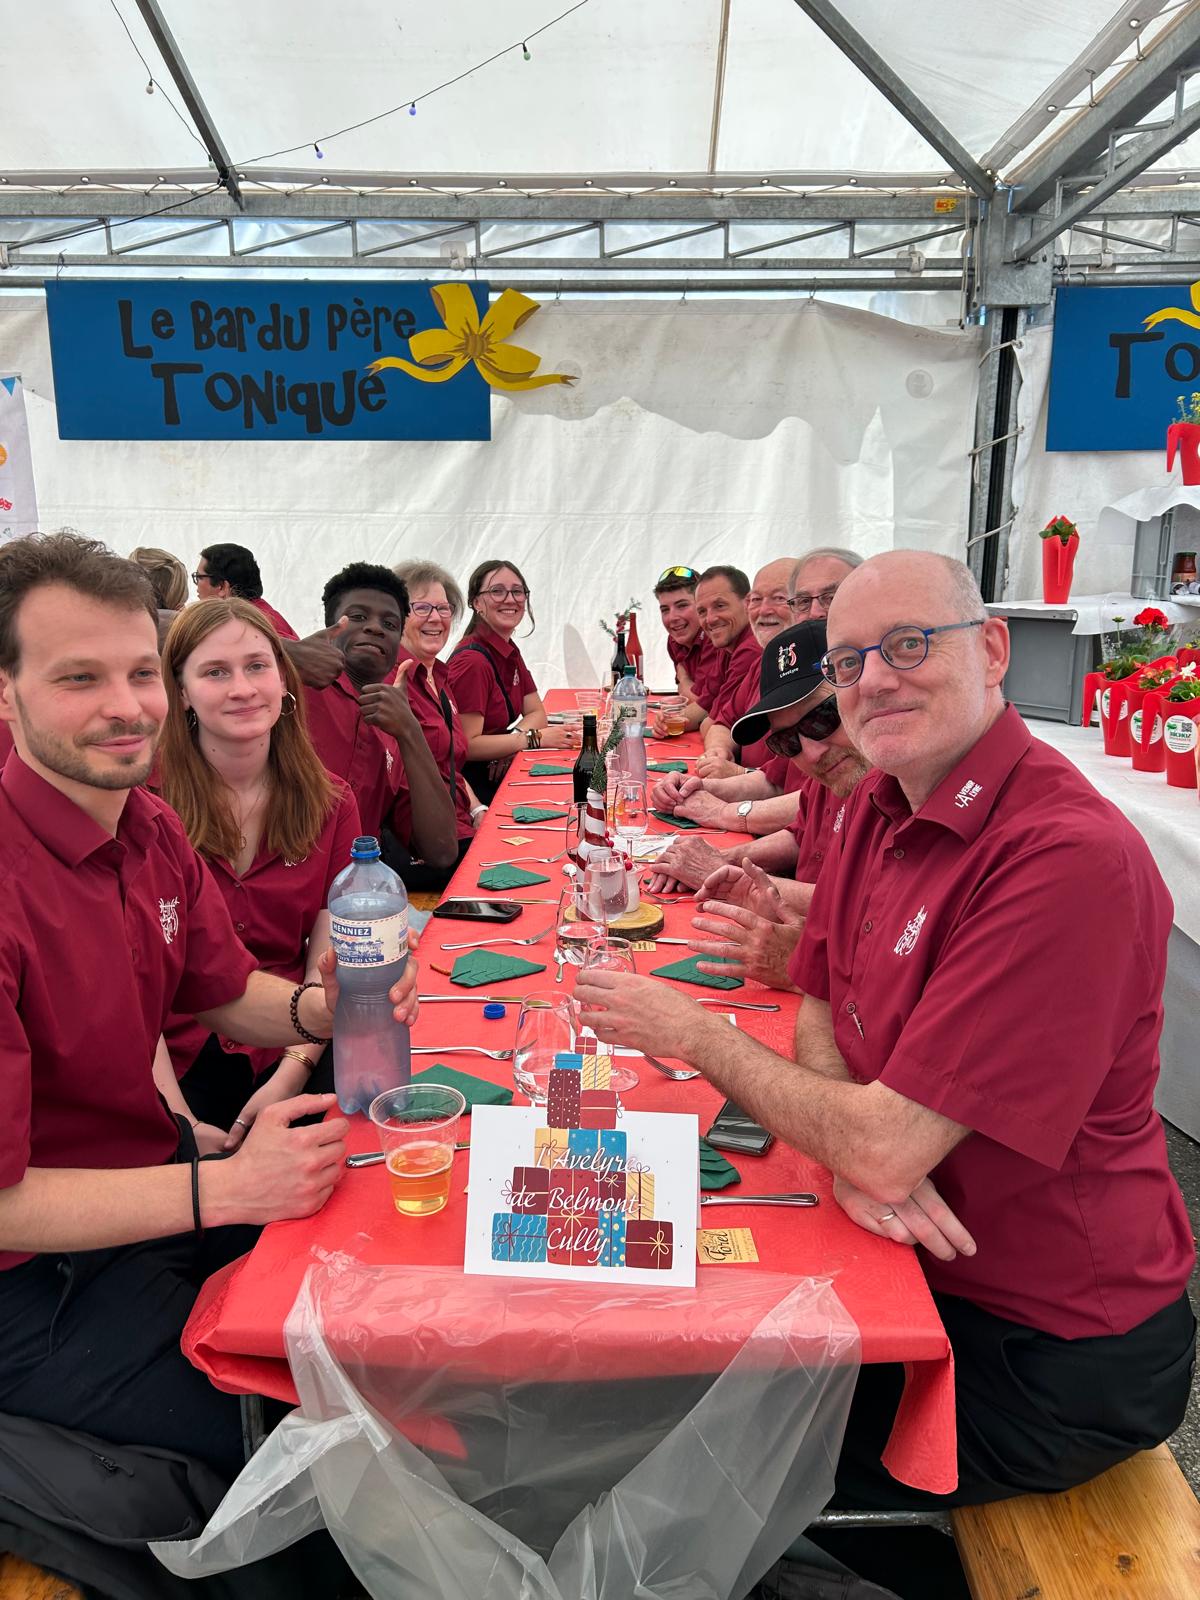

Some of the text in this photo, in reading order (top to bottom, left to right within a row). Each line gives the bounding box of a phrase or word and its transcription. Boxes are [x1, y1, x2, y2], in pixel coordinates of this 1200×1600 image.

[118, 299, 176, 359] Le
[190, 300, 256, 352] Bar
[333, 923, 370, 936] HENNIEZ
[536, 1146, 637, 1182] L'Avelyre
[510, 1185, 537, 1208] de
[547, 1227, 609, 1264] Cully
